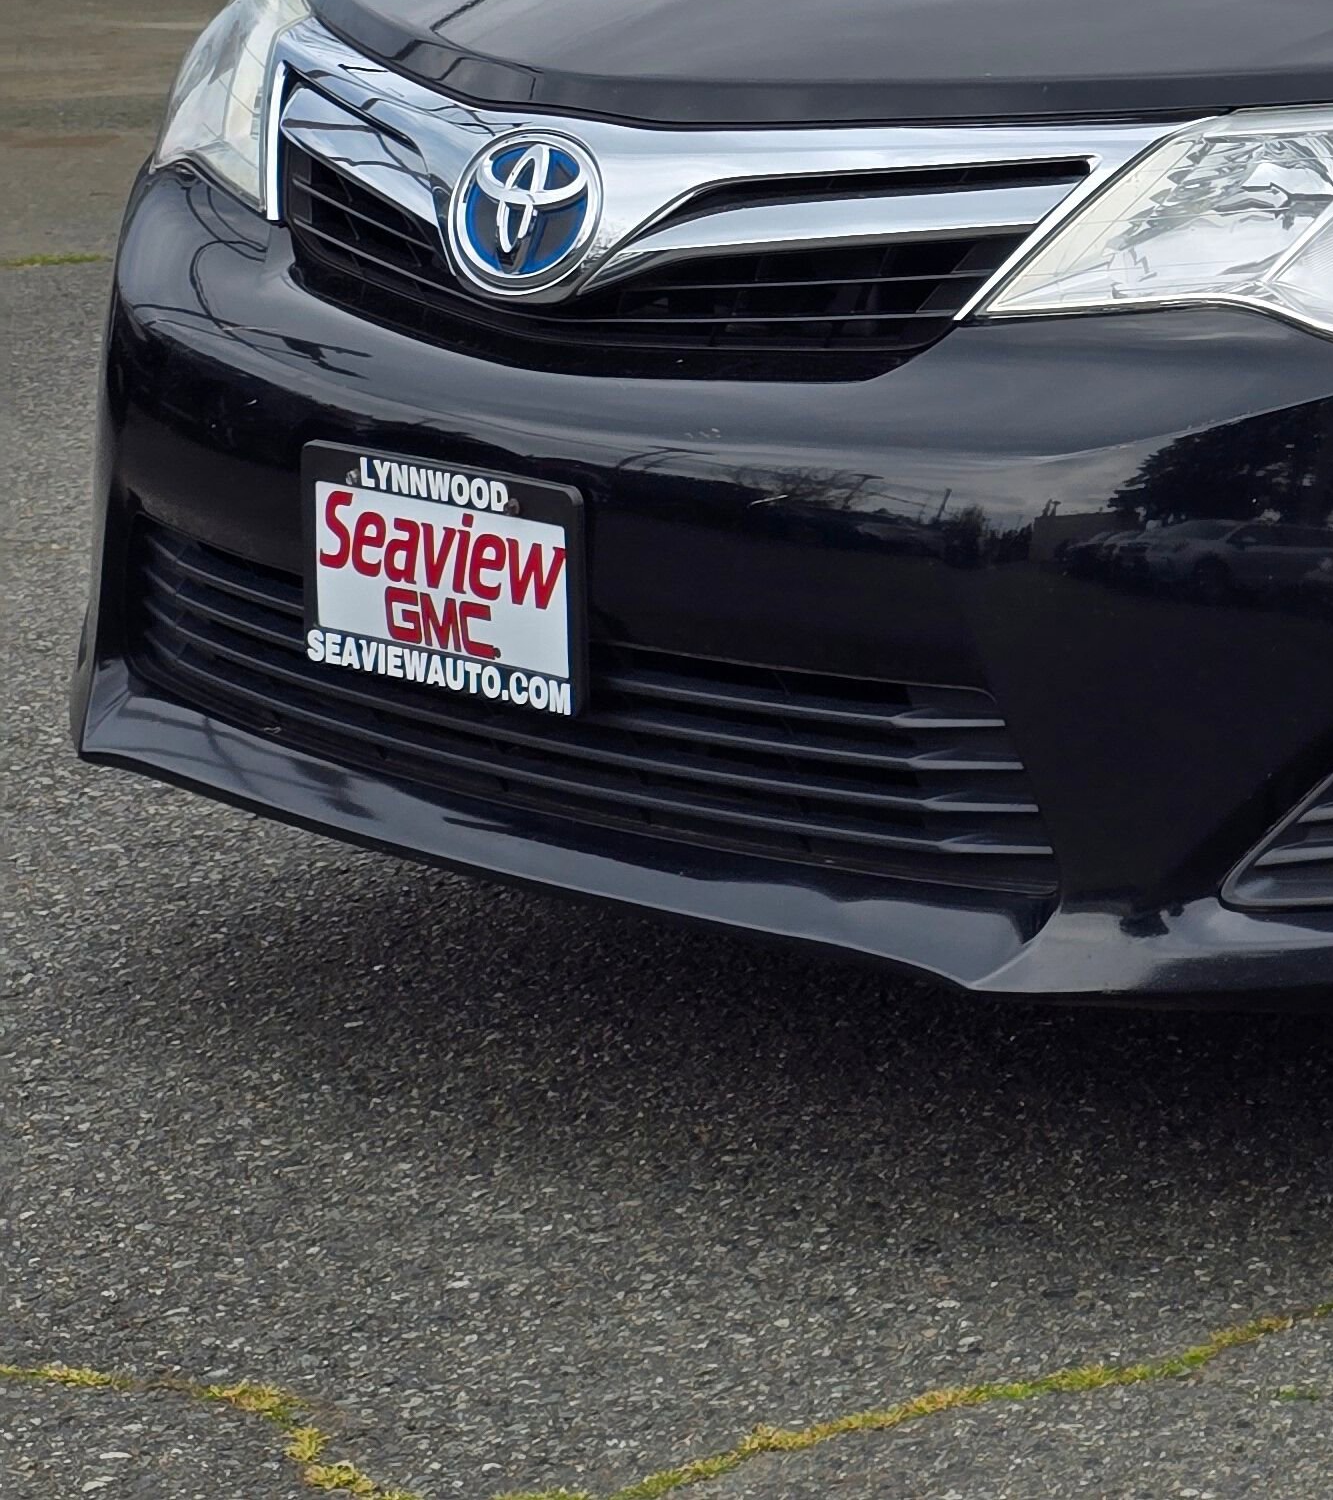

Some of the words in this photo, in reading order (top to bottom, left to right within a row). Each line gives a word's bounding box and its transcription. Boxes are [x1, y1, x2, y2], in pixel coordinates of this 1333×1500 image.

[359, 456, 509, 513] LYNNWOOD
[319, 490, 567, 610] Seaview
[384, 586, 499, 661] GMC
[306, 629, 572, 716] SEAVIEWAUTO.COM
